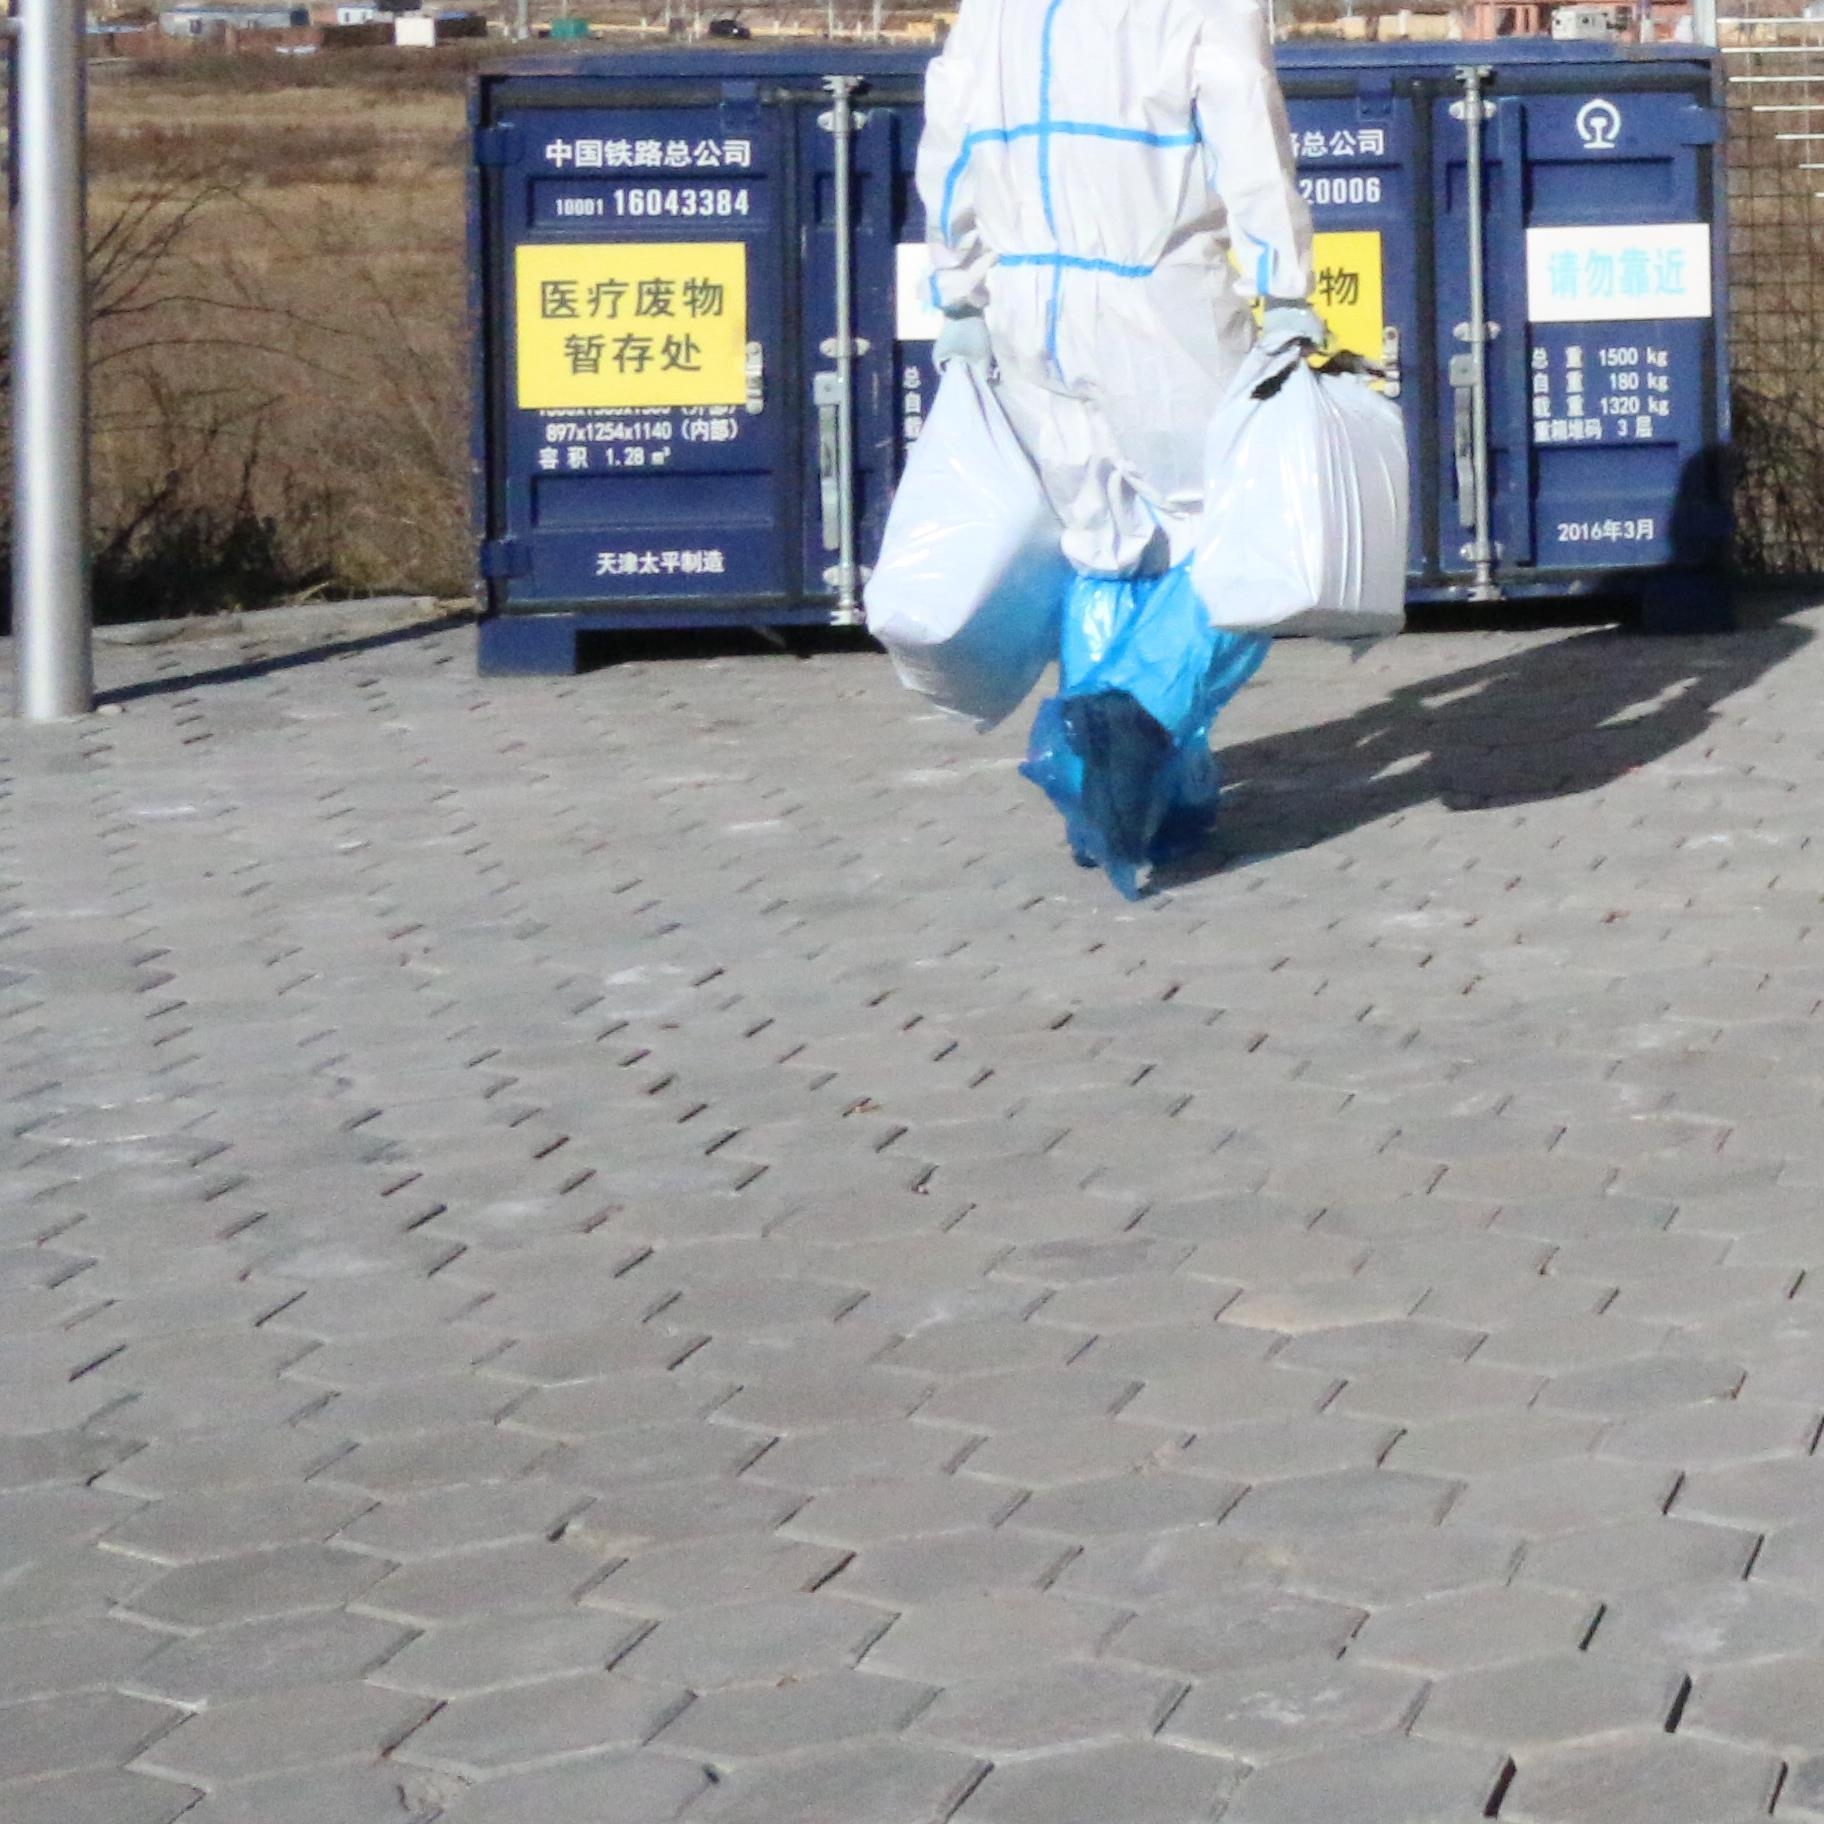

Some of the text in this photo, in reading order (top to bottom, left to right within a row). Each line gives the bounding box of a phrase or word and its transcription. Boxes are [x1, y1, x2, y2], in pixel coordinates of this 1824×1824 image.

[545, 138, 751, 168] 中国铁路总公司
[555, 188, 750, 216] 10001 16043384
[1547, 245, 1687, 298] 请勿靠近
[541, 277, 724, 319] 医疗废物
[564, 333, 702, 374] 暂存处
[1600, 347, 1639, 367] 1500
[1646, 346, 1668, 368] kg
[1610, 372, 1639, 391] 180
[1647, 372, 1669, 393] kg
[1600, 396, 1640, 416] 1320
[1647, 396, 1670, 417] kg
[1557, 518, 1654, 543] 2016年3月
